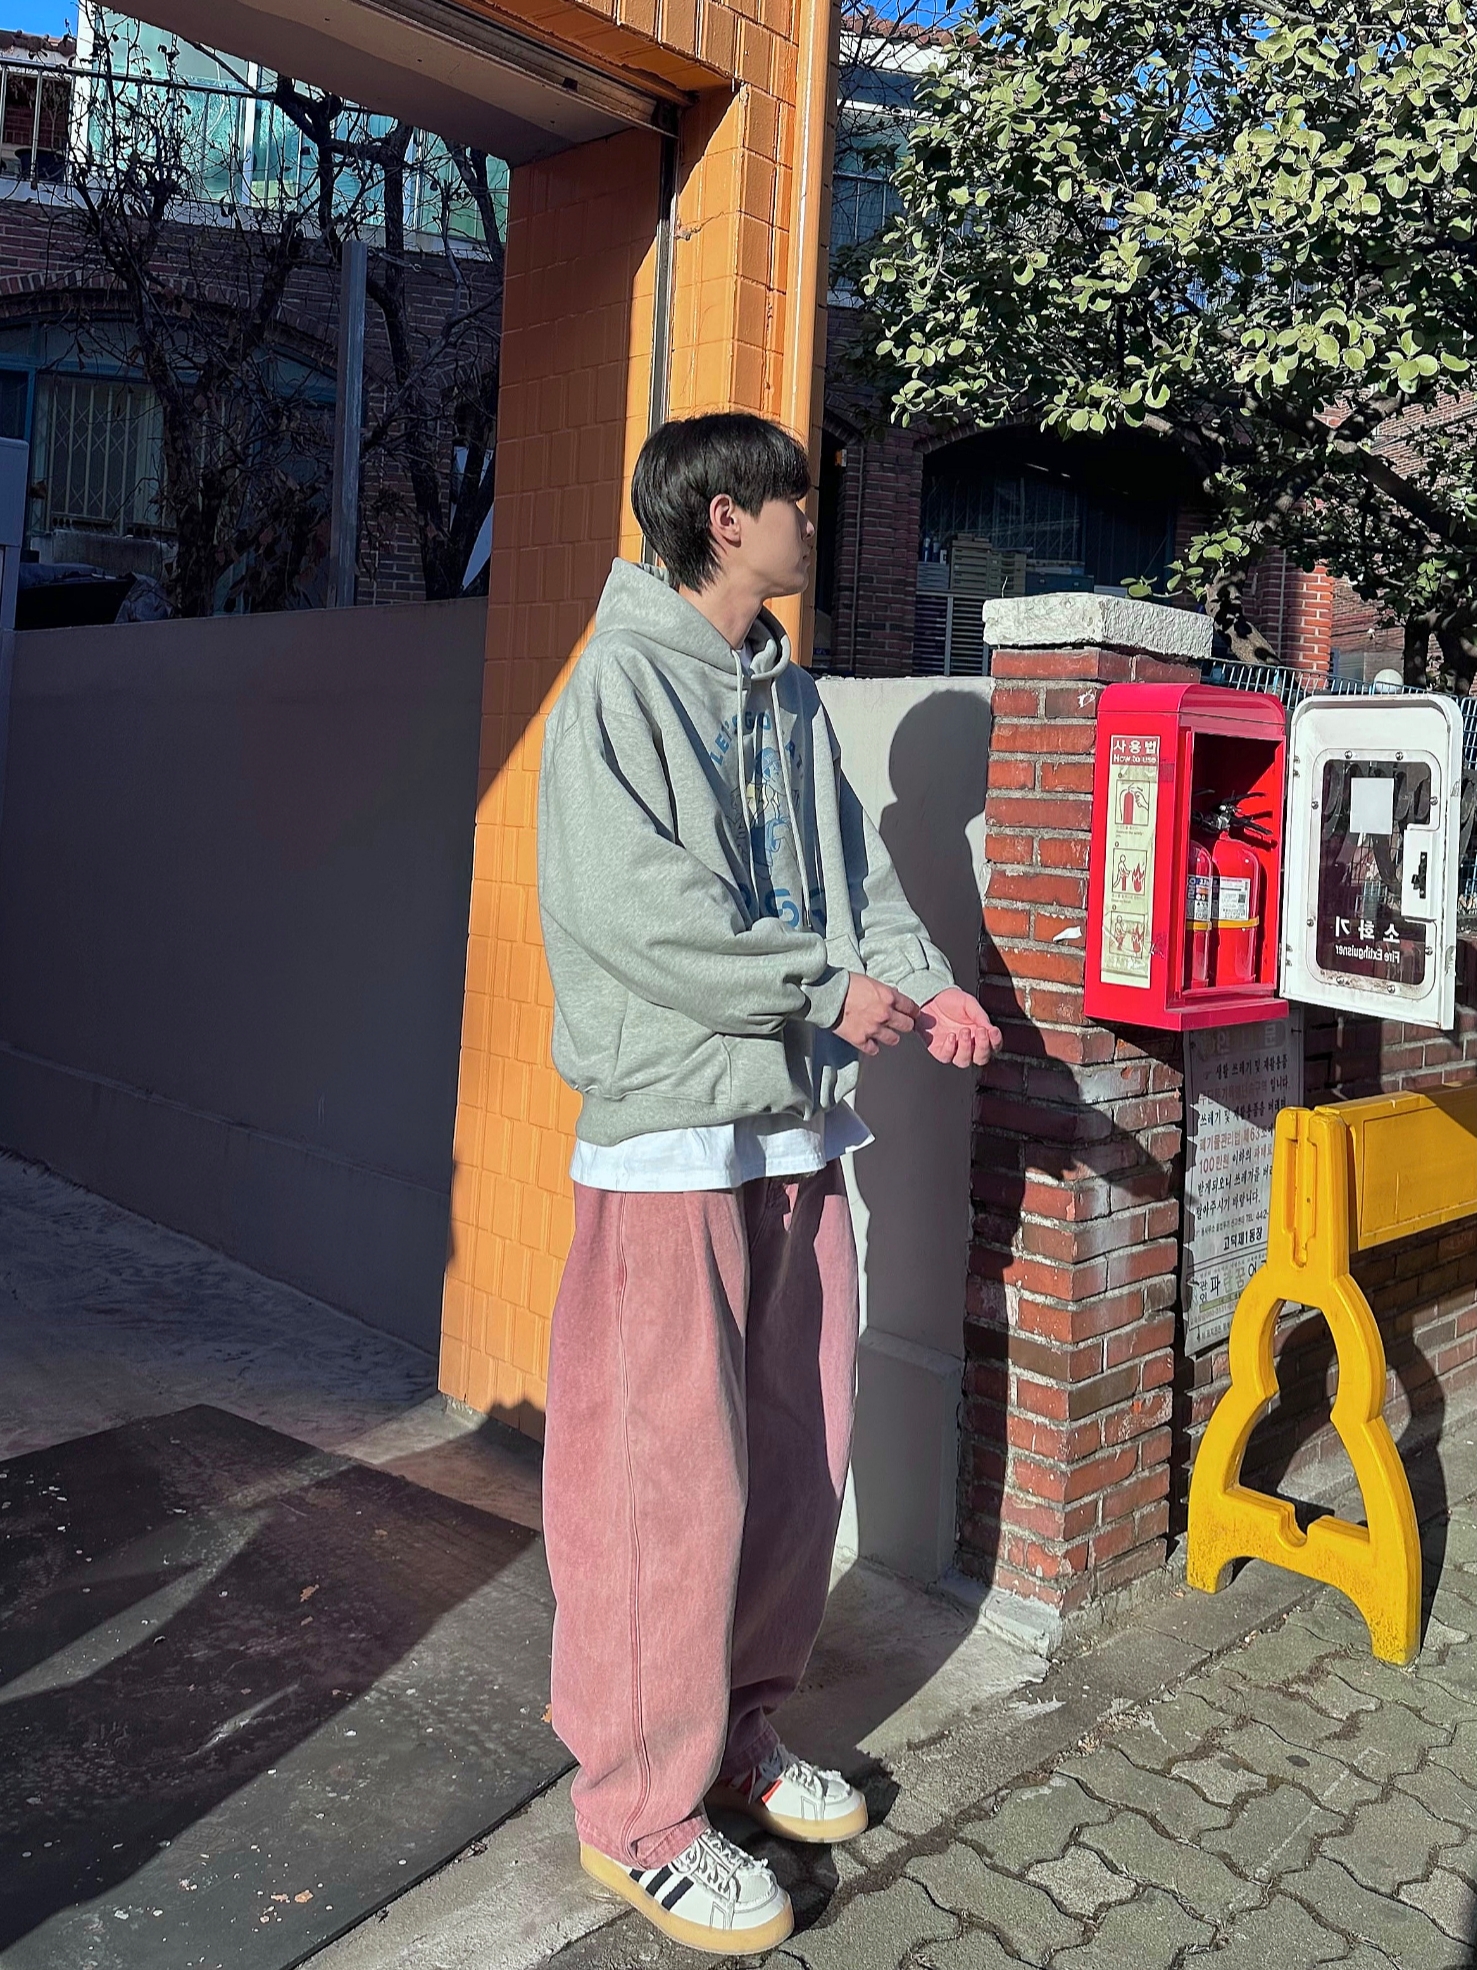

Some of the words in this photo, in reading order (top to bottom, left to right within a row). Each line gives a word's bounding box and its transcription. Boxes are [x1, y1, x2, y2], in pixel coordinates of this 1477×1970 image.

[1113, 740, 1157, 754] 사용법
[1113, 754, 1131, 763] How
[1132, 755, 1140, 763] to
[1142, 756, 1157, 764] use
[1232, 1059, 1252, 1075] 쓰레기
[1200, 1109, 1221, 1127] 쓰레기
[1200, 1131, 1240, 1153] 폐기물관리법
[1200, 1153, 1229, 1174] 100만원
[1232, 1147, 1252, 1165] 이하의
[1234, 1166, 1260, 1186] 쓰레기를
[1232, 1188, 1260, 1210] 바랍니다.
[1223, 1226, 1263, 1251] 고덕제1동장
